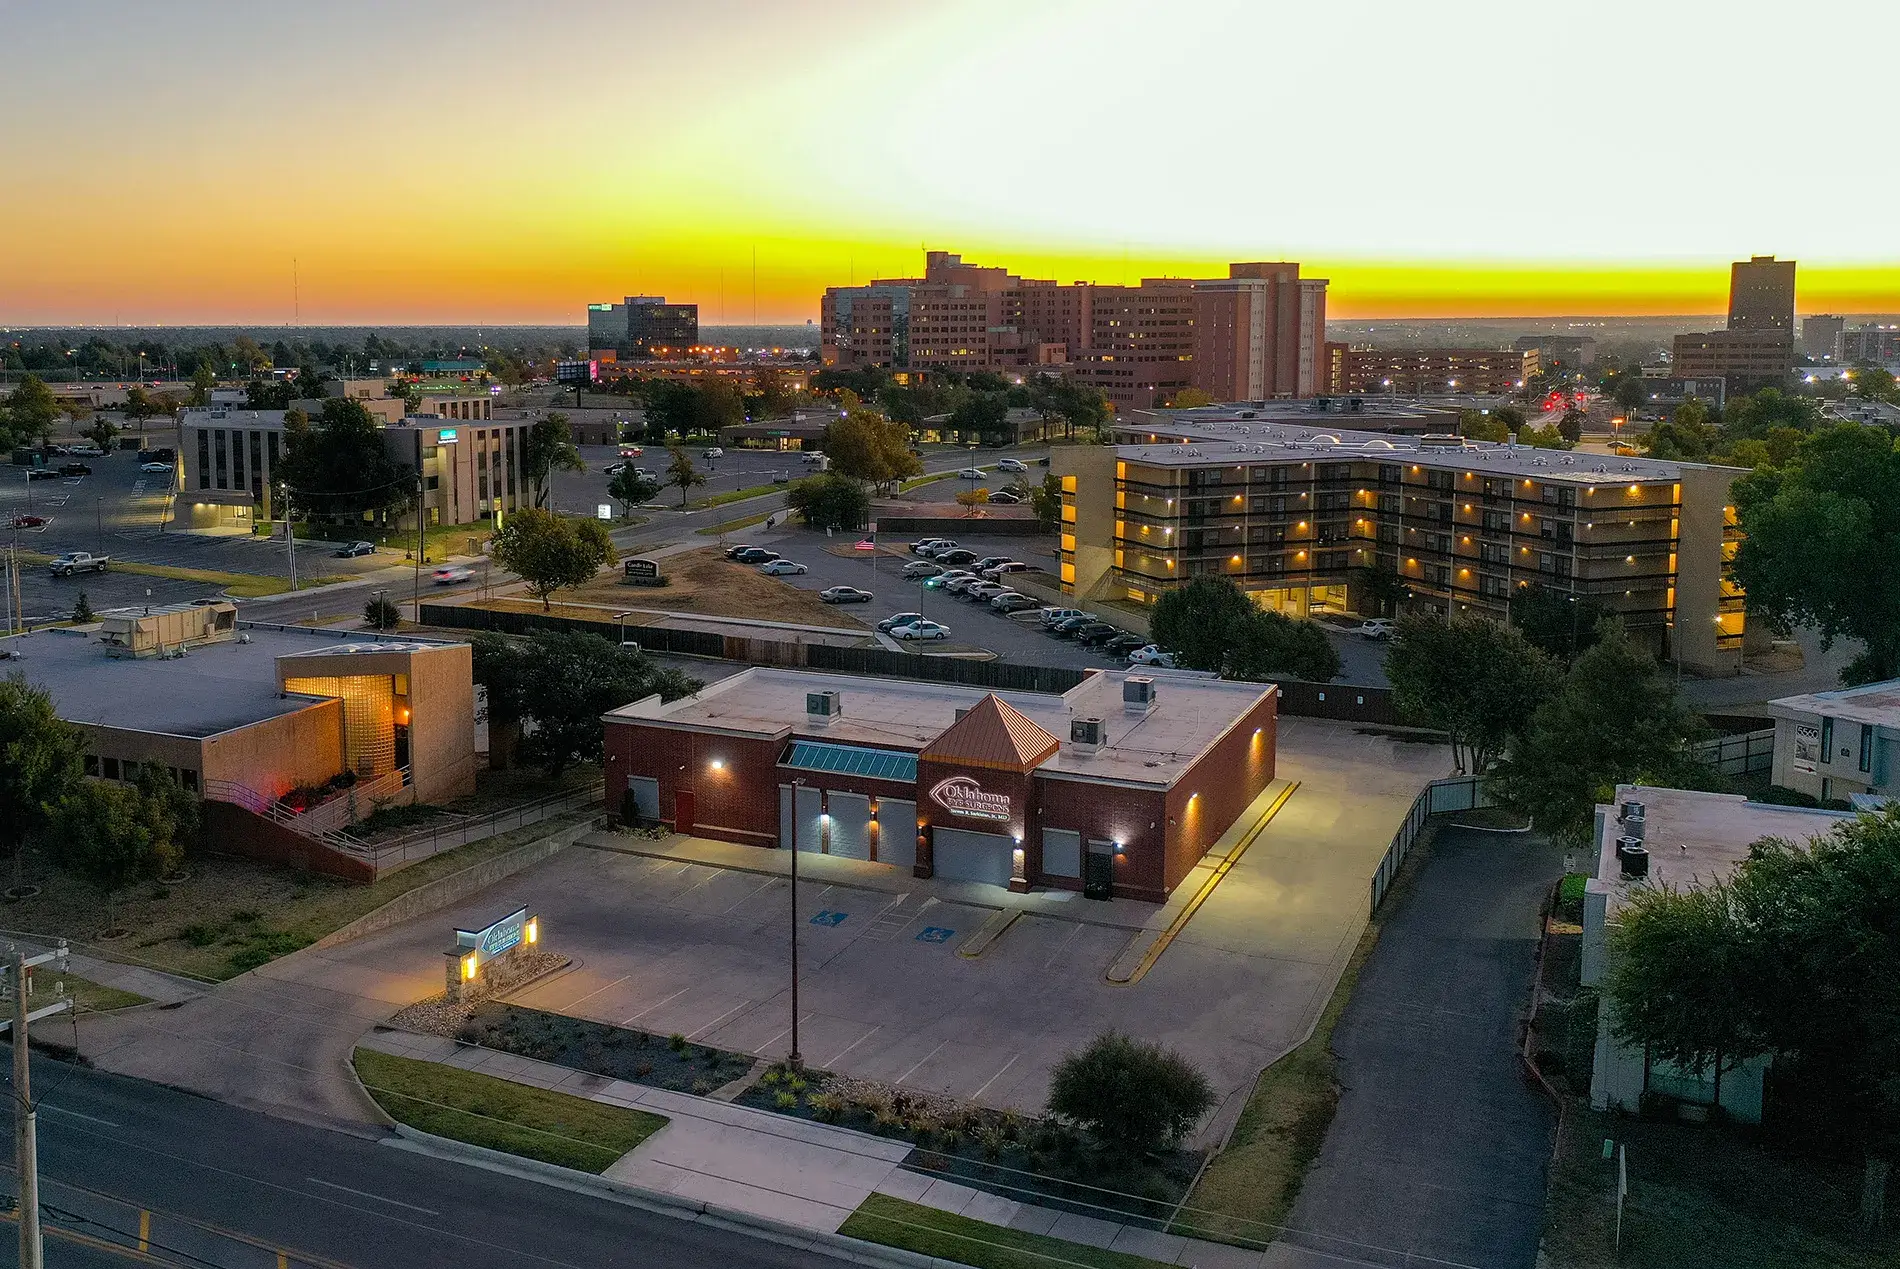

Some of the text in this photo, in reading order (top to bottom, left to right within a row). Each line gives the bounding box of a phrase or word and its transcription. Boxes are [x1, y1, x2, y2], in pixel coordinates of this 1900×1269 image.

[1797, 725, 1819, 740] 5560
[942, 785, 1010, 804] Oklahoma
[947, 797, 1010, 813] EYE SURGEONS
[487, 922, 520, 945] Oklahoma
